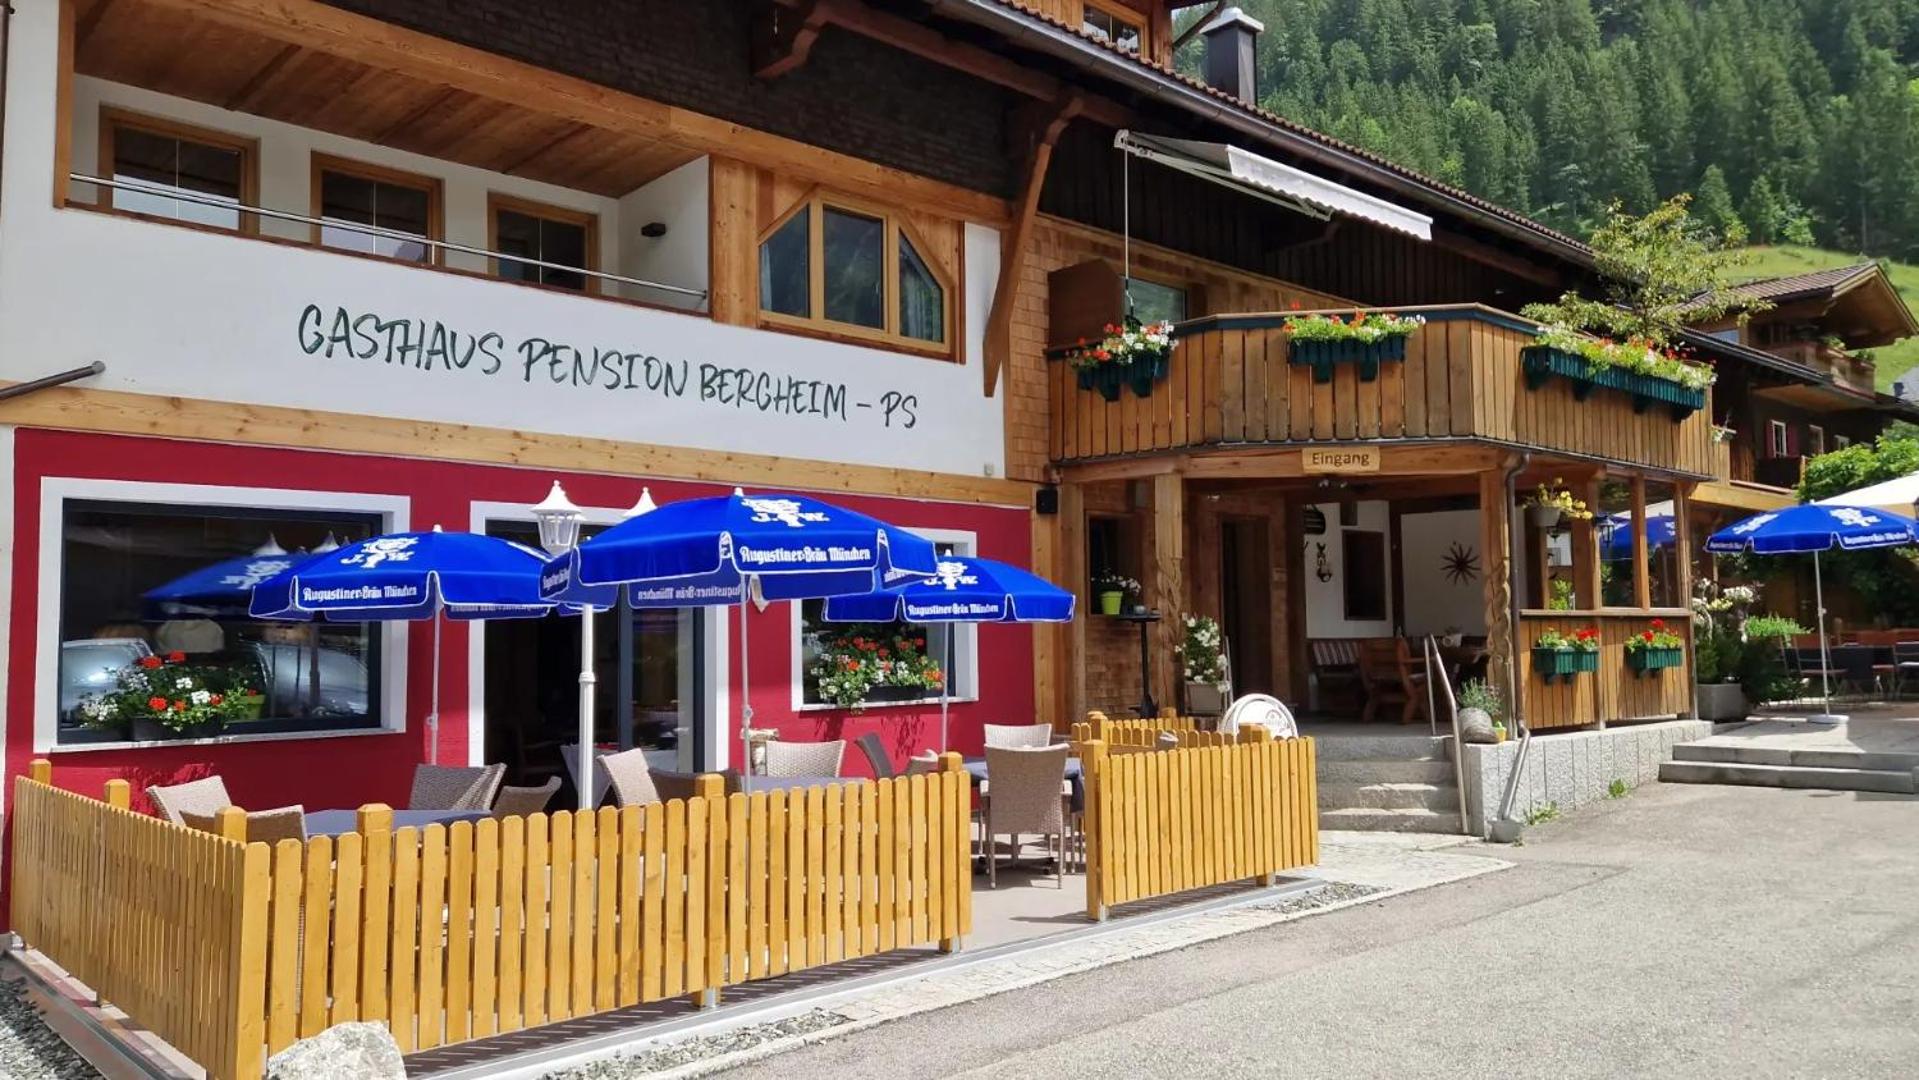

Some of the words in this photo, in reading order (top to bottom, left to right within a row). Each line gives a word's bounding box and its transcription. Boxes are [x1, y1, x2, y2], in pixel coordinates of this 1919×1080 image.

[299, 304, 503, 375] GASTHAUS
[518, 338, 688, 397] PENSION
[700, 363, 846, 421] BERGHEIM
[880, 391, 917, 428] PS
[1312, 452, 1369, 467] Eingang
